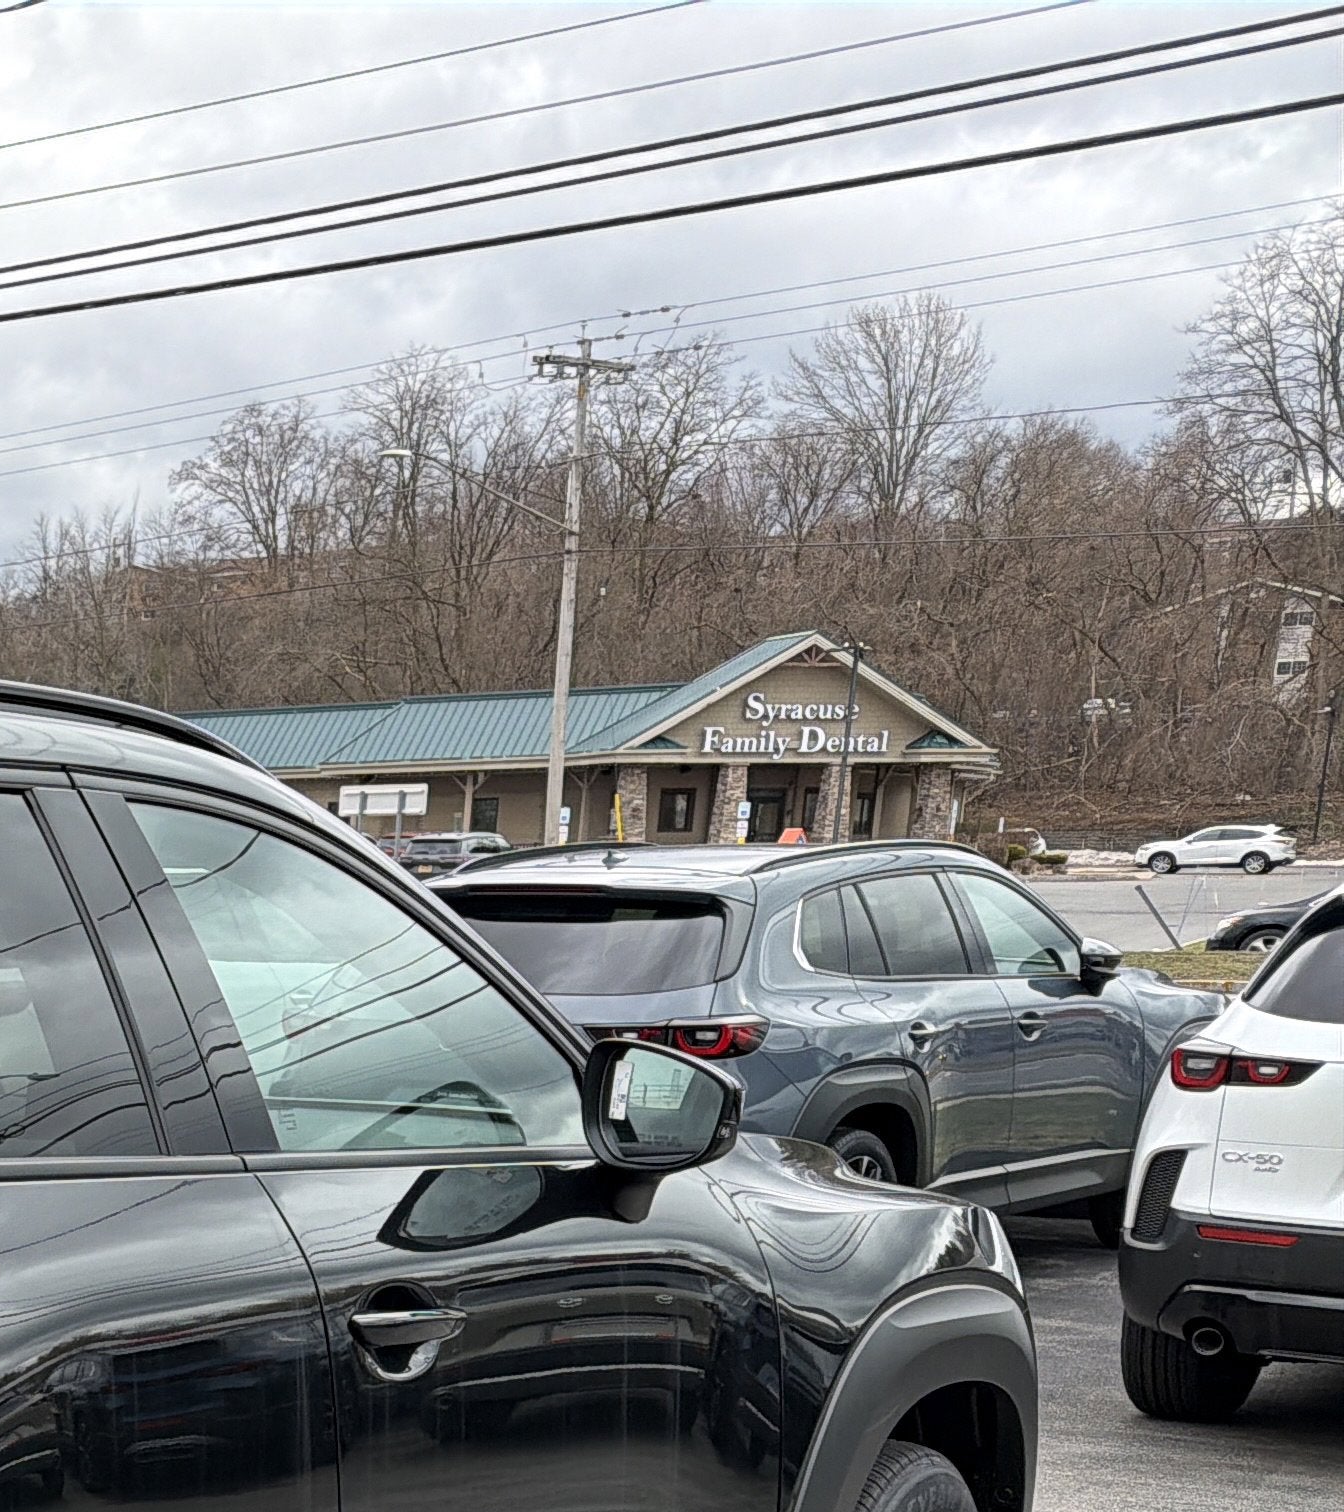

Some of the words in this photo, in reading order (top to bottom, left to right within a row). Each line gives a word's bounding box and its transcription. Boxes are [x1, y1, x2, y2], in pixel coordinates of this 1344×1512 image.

[745, 692, 860, 727] Syracuse
[700, 726, 792, 760] Family
[797, 725, 890, 753] Dental
[1221, 1150, 1285, 1166] CX-50
